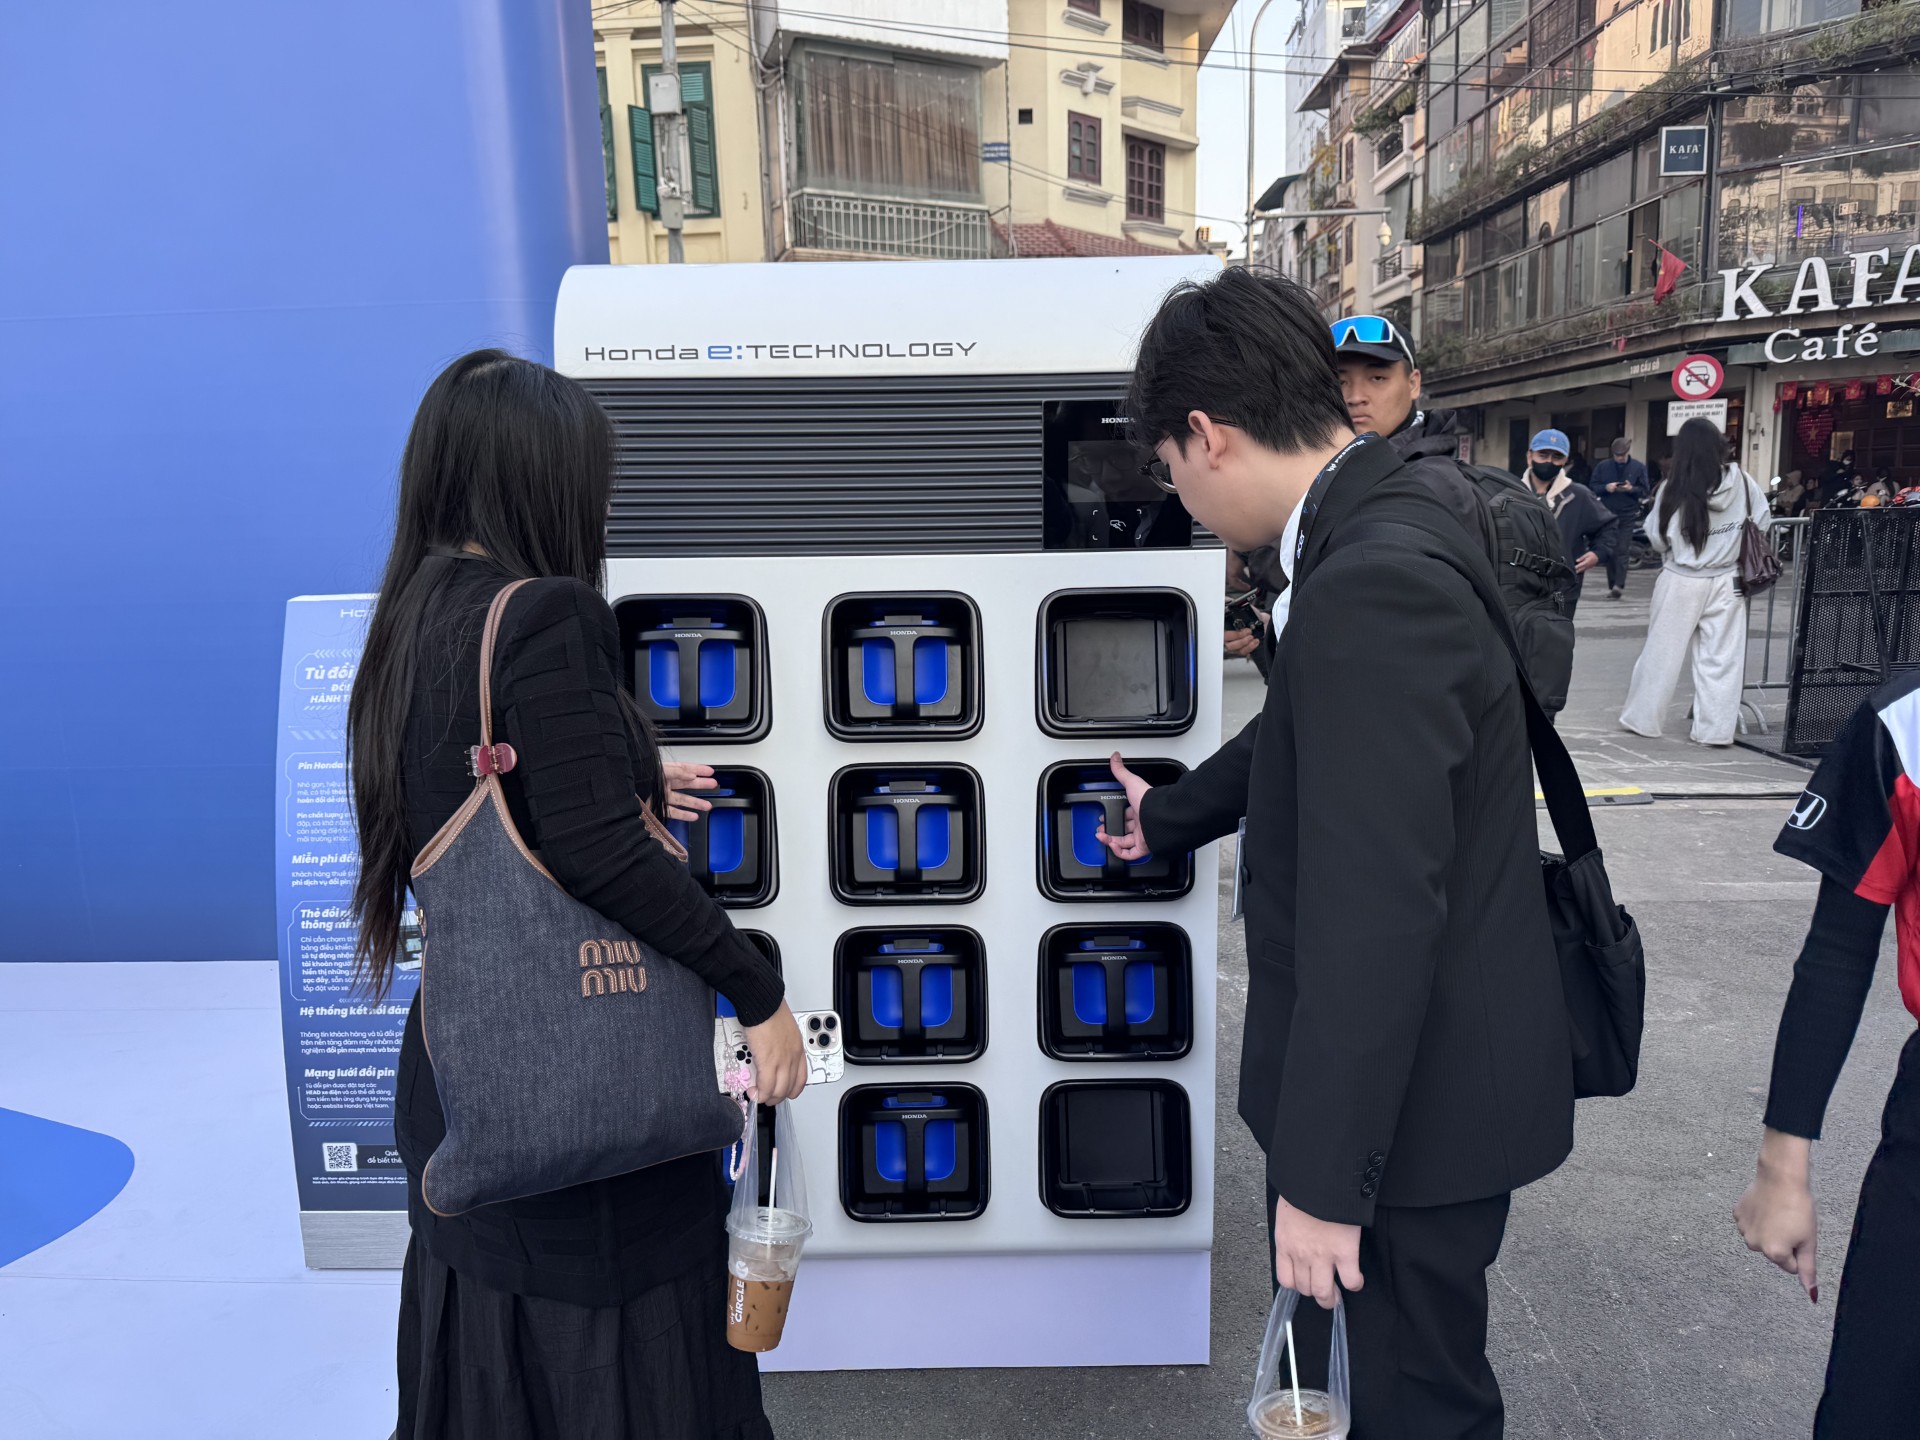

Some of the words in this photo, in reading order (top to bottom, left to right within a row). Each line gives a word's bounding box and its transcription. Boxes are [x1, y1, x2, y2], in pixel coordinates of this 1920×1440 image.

[1669, 144, 1699, 154] KAFA
[1716, 243, 1920, 322] KAFA
[1764, 322, 1879, 364] Café
[585, 345, 699, 361] Honda
[305, 665, 325, 680] Tủ
[298, 761, 313, 770] Pin
[292, 852, 318, 864] Miễn
[319, 853, 338, 866] phí
[321, 906, 339, 918] đổi
[301, 919, 333, 931] thông
[318, 952, 336, 960] động
[300, 1006, 315, 1018] Hệ
[316, 1004, 348, 1018] thống
[349, 1002, 368, 1015] kết
[300, 1031, 320, 1039] Thông
[304, 1068, 336, 1080] Mạng
[337, 1067, 358, 1077] lưới
[359, 1065, 376, 1077] đổi
[376, 1067, 395, 1080] pin
[735, 1280, 744, 1322] CIRCLE
